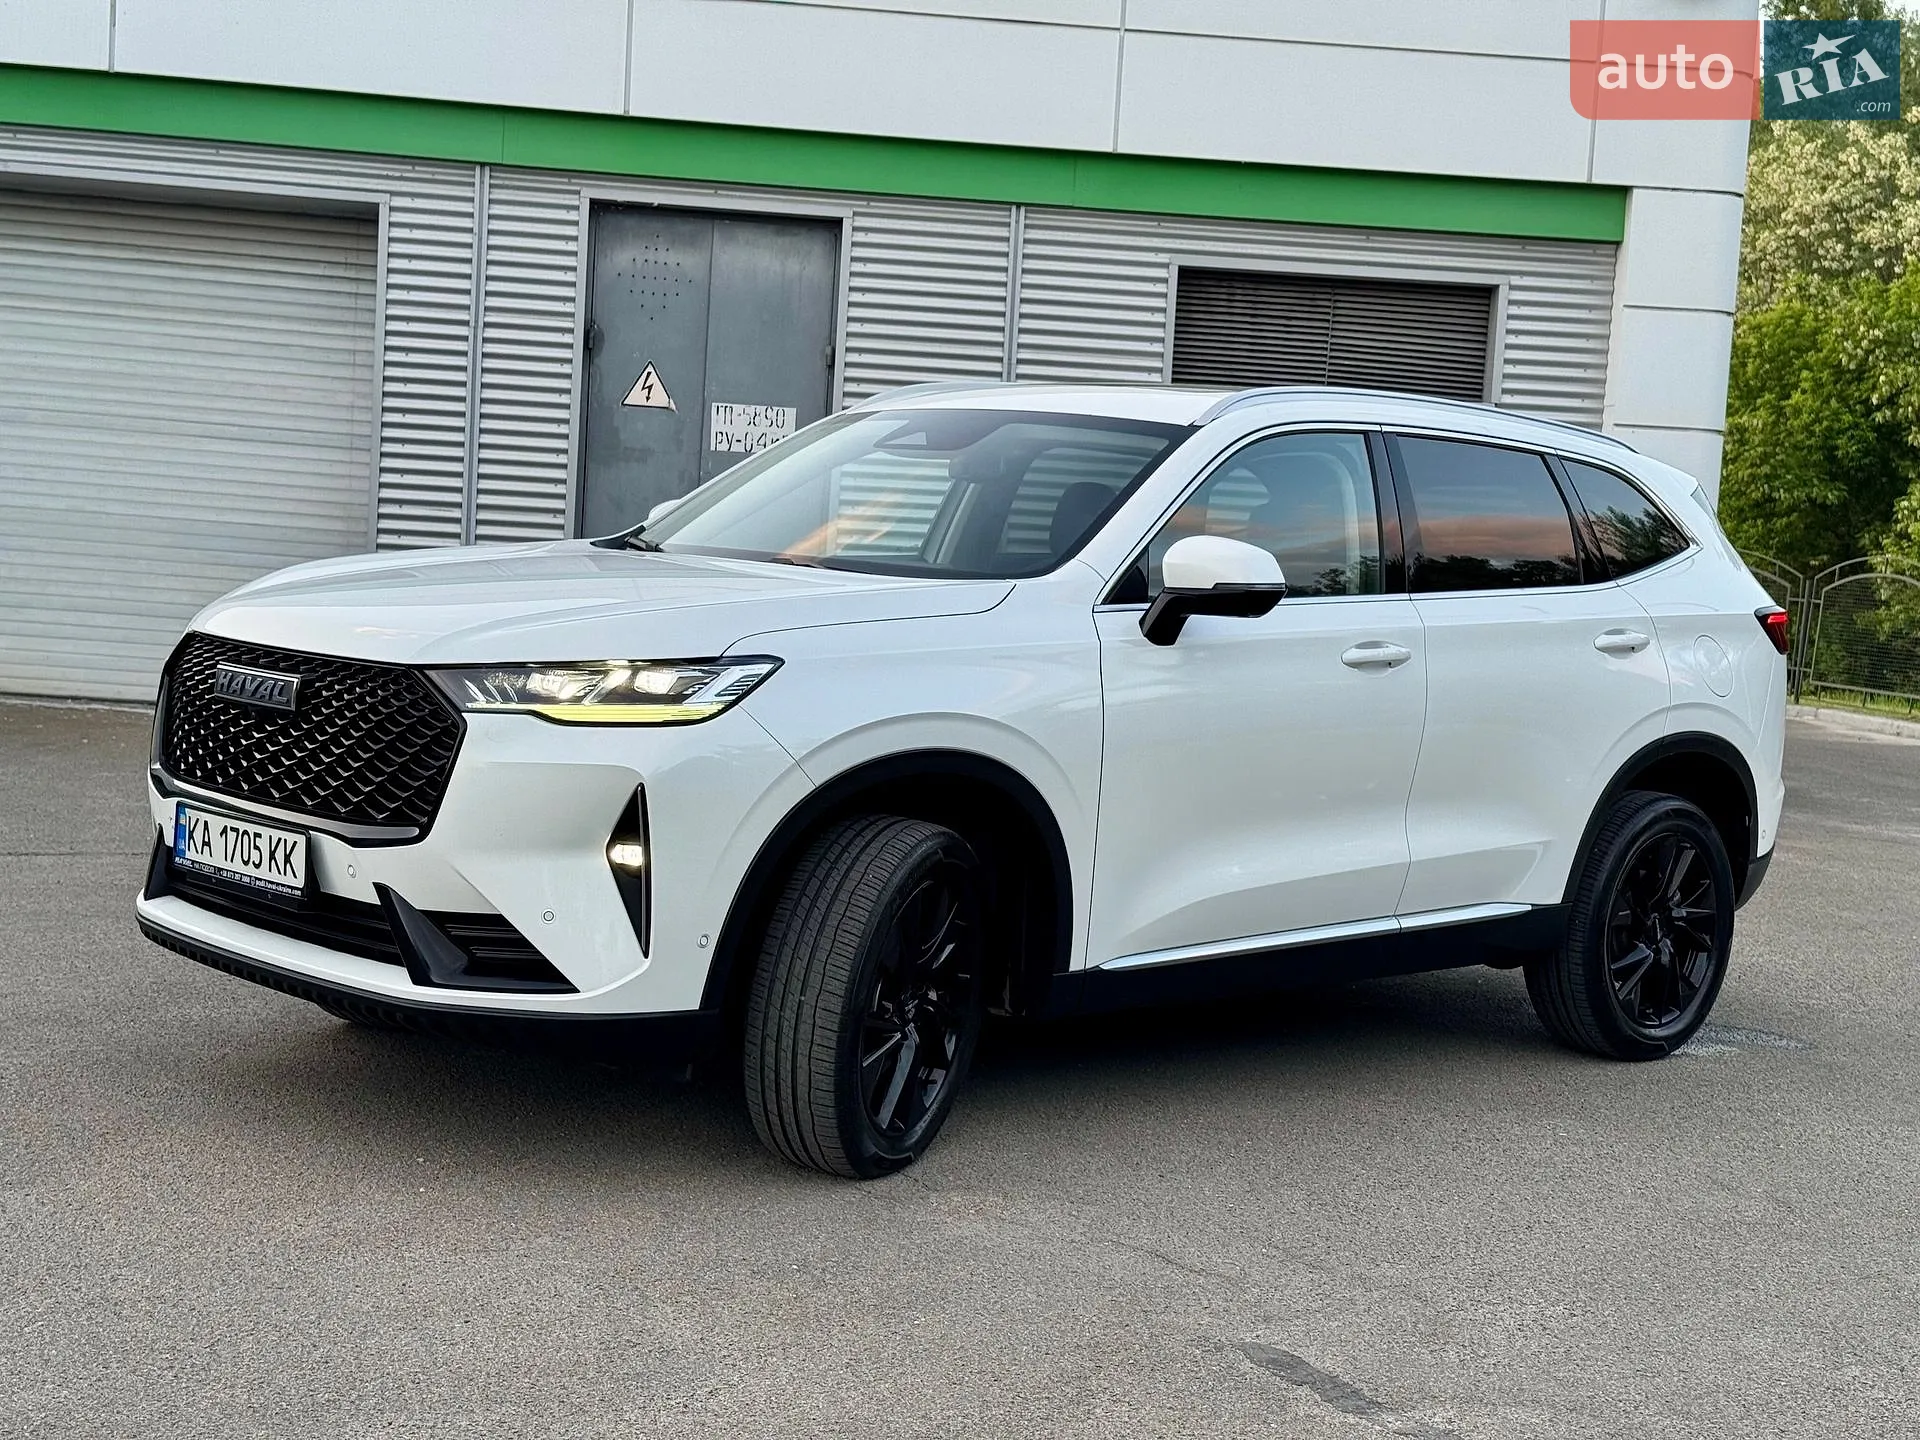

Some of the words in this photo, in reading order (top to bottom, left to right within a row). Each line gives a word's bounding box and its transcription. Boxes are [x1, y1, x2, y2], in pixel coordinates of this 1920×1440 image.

[217, 671, 288, 704] HAVAL
[187, 815, 213, 858] KA
[219, 824, 263, 870] 1705
[268, 834, 298, 879] KK
